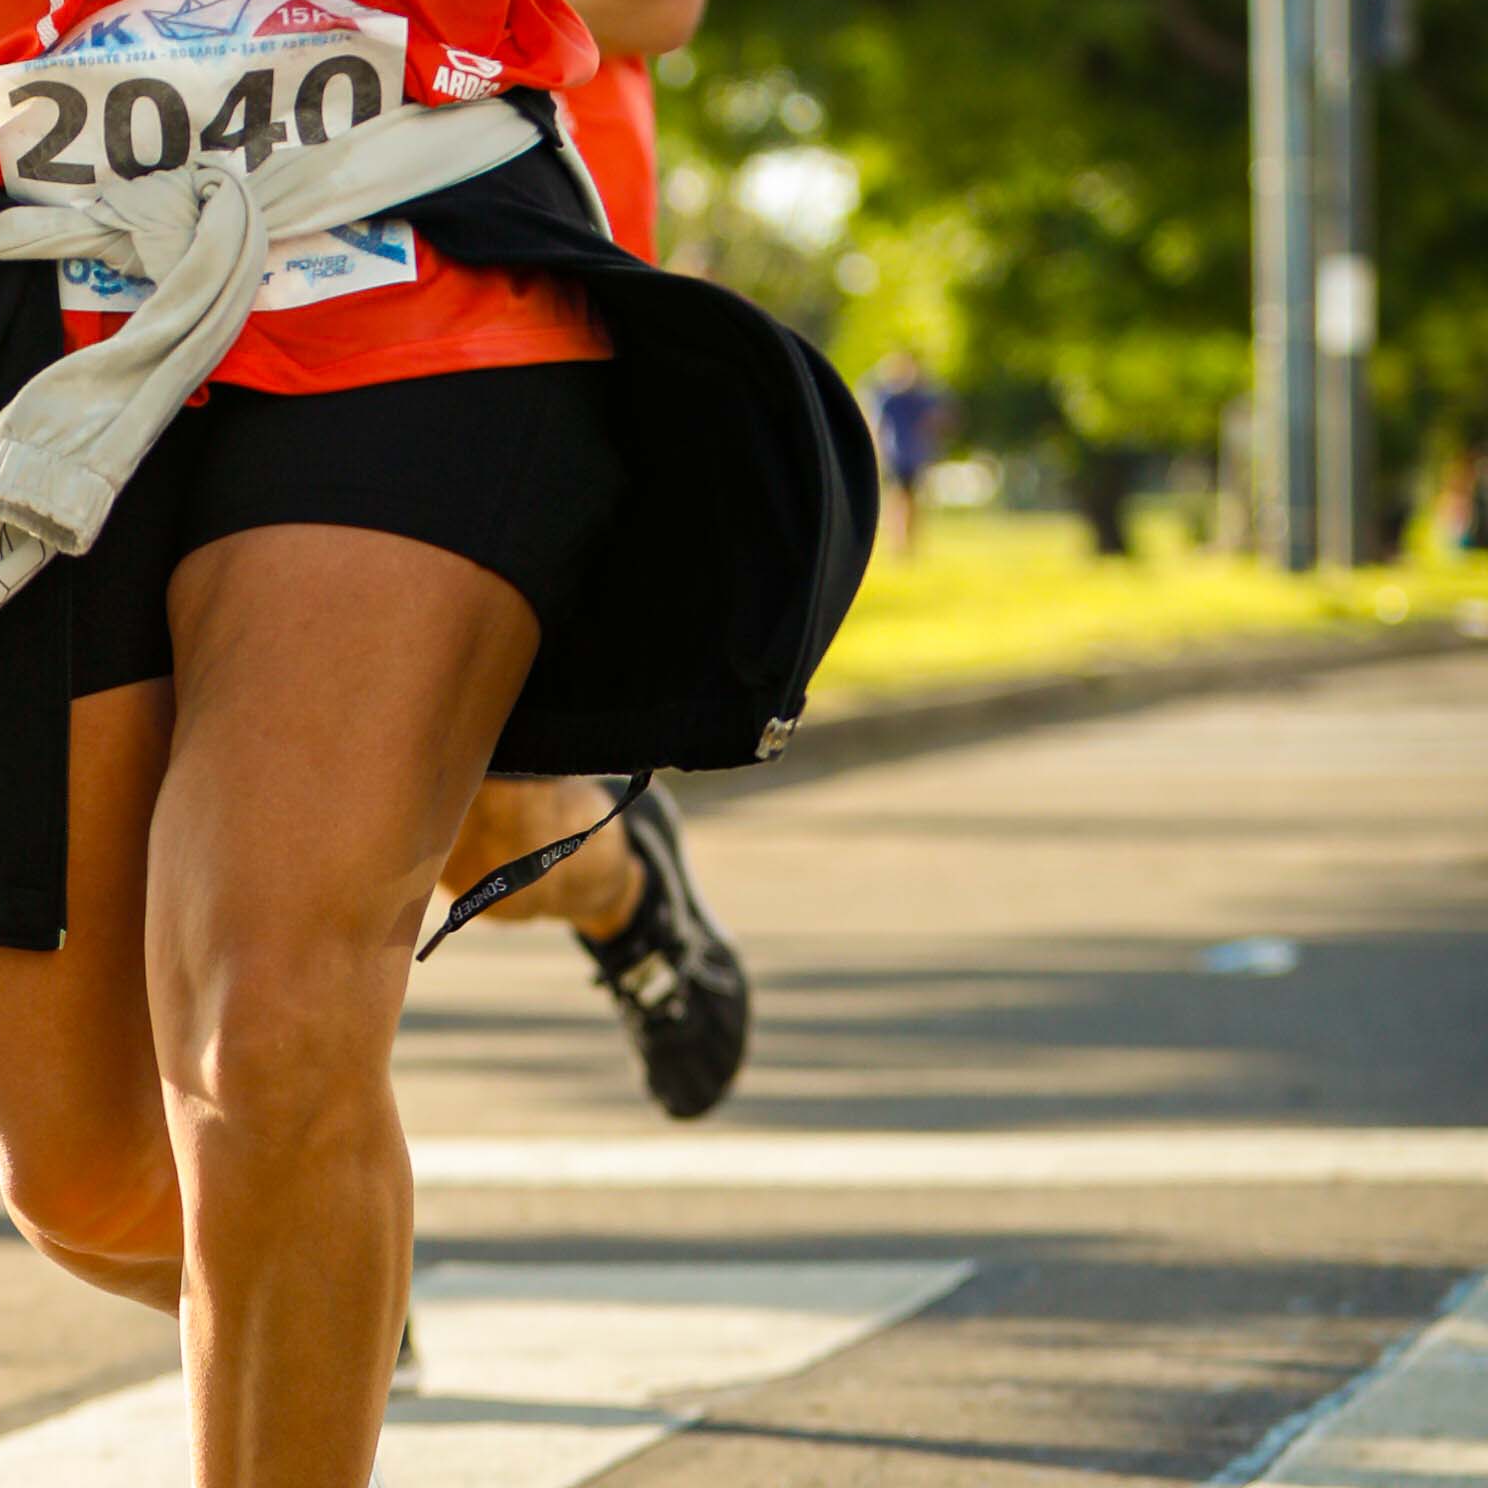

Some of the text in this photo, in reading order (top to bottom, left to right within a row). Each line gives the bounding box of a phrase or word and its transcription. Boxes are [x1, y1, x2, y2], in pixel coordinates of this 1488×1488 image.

[9, 55, 382, 185] 2040
[286, 255, 348, 271] POWER
[452, 876, 508, 921] SONDER
